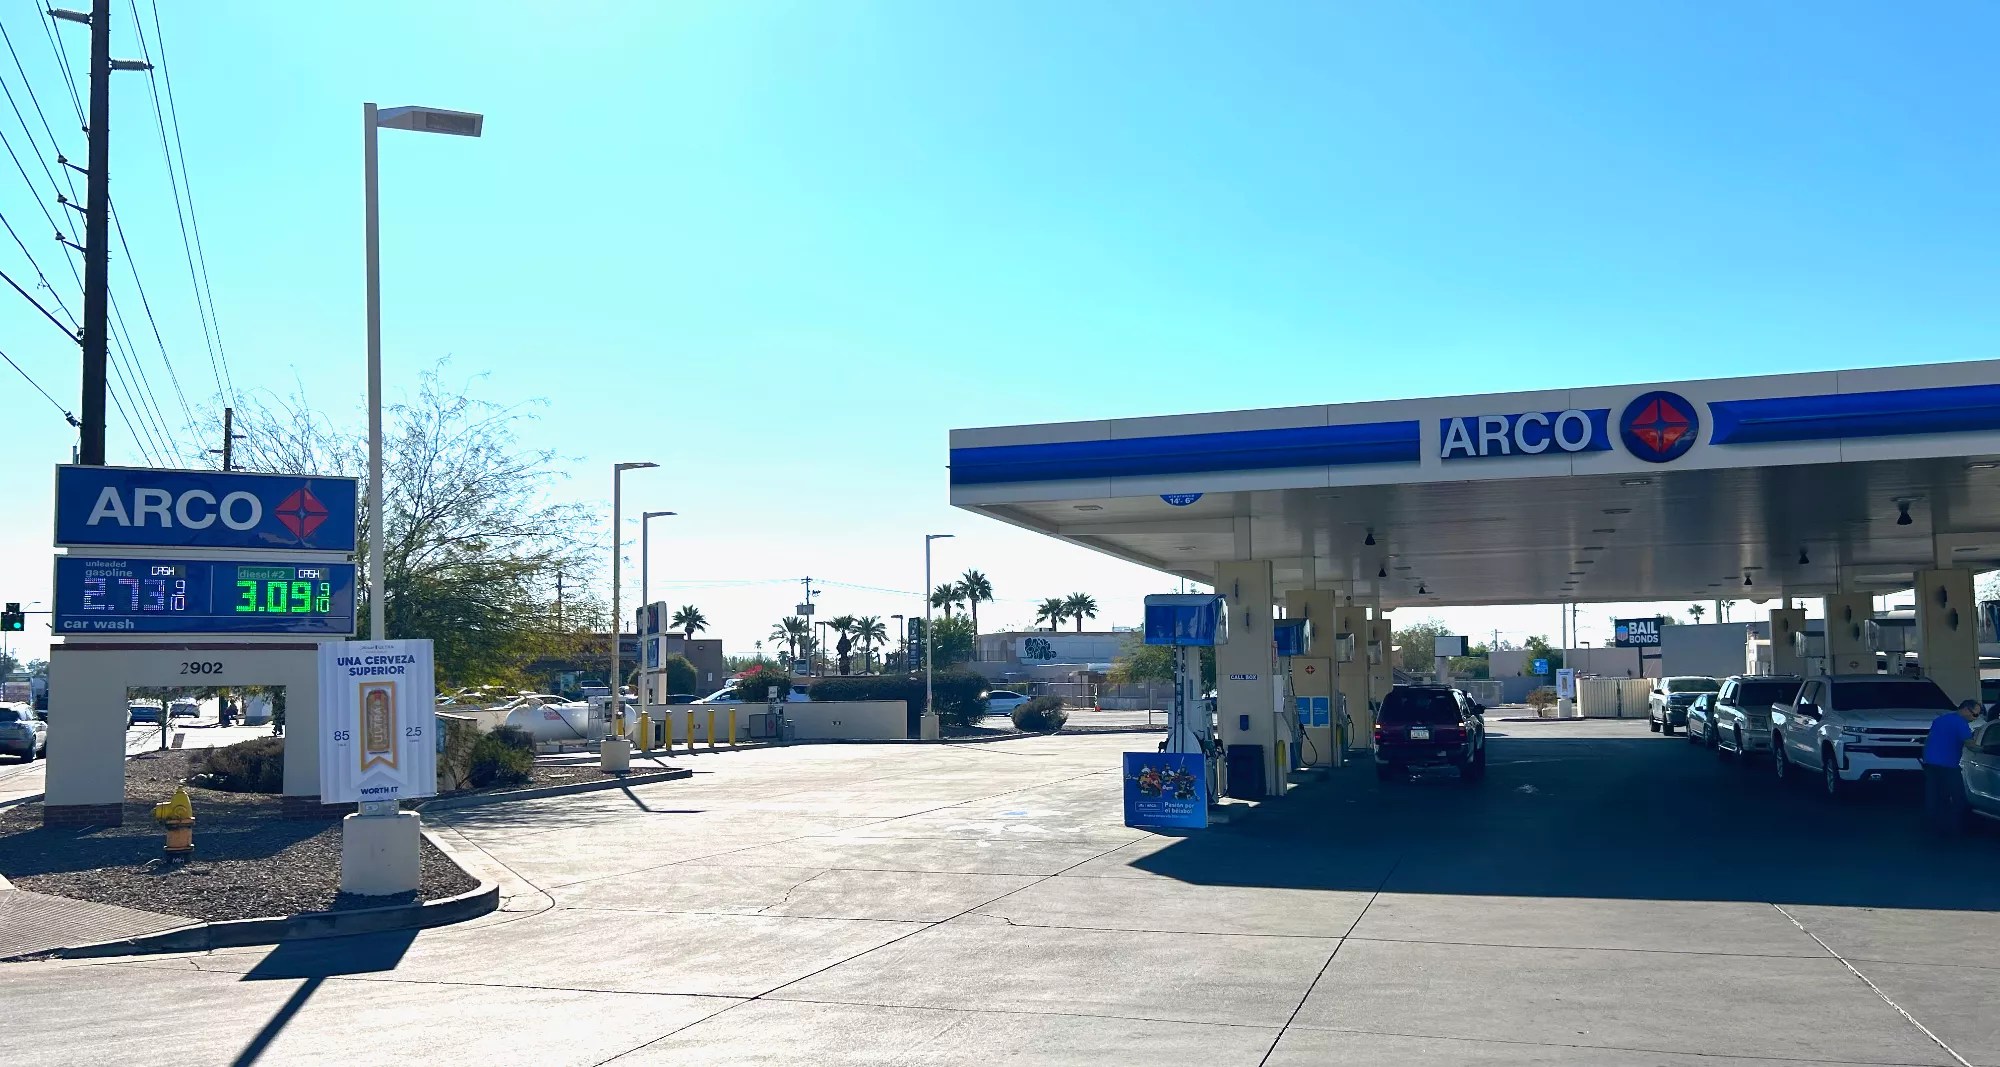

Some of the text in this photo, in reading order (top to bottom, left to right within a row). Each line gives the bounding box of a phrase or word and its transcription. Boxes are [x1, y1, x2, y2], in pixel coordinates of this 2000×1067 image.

[1441, 409, 1593, 458] ARCO
[86, 486, 263, 531] ARCO
[85, 560, 127, 568] unleaded
[85, 568, 133, 578] gasoline
[151, 566, 175, 576] CASH
[298, 569, 320, 579] CASH
[83, 577, 166, 611] 2.73
[236, 580, 312, 613] 3.09
[63, 618, 135, 629] car wash
[1628, 621, 1658, 635] BAIL
[1629, 635, 1659, 644] BONDS
[337, 655, 415, 666] UNA CERVEZA
[180, 661, 223, 674] 2902
[348, 665, 405, 677] SUPERIOR
[333, 730, 350, 741] 85
[405, 726, 422, 737] 2.5
[361, 786, 398, 795] WORTH IT
